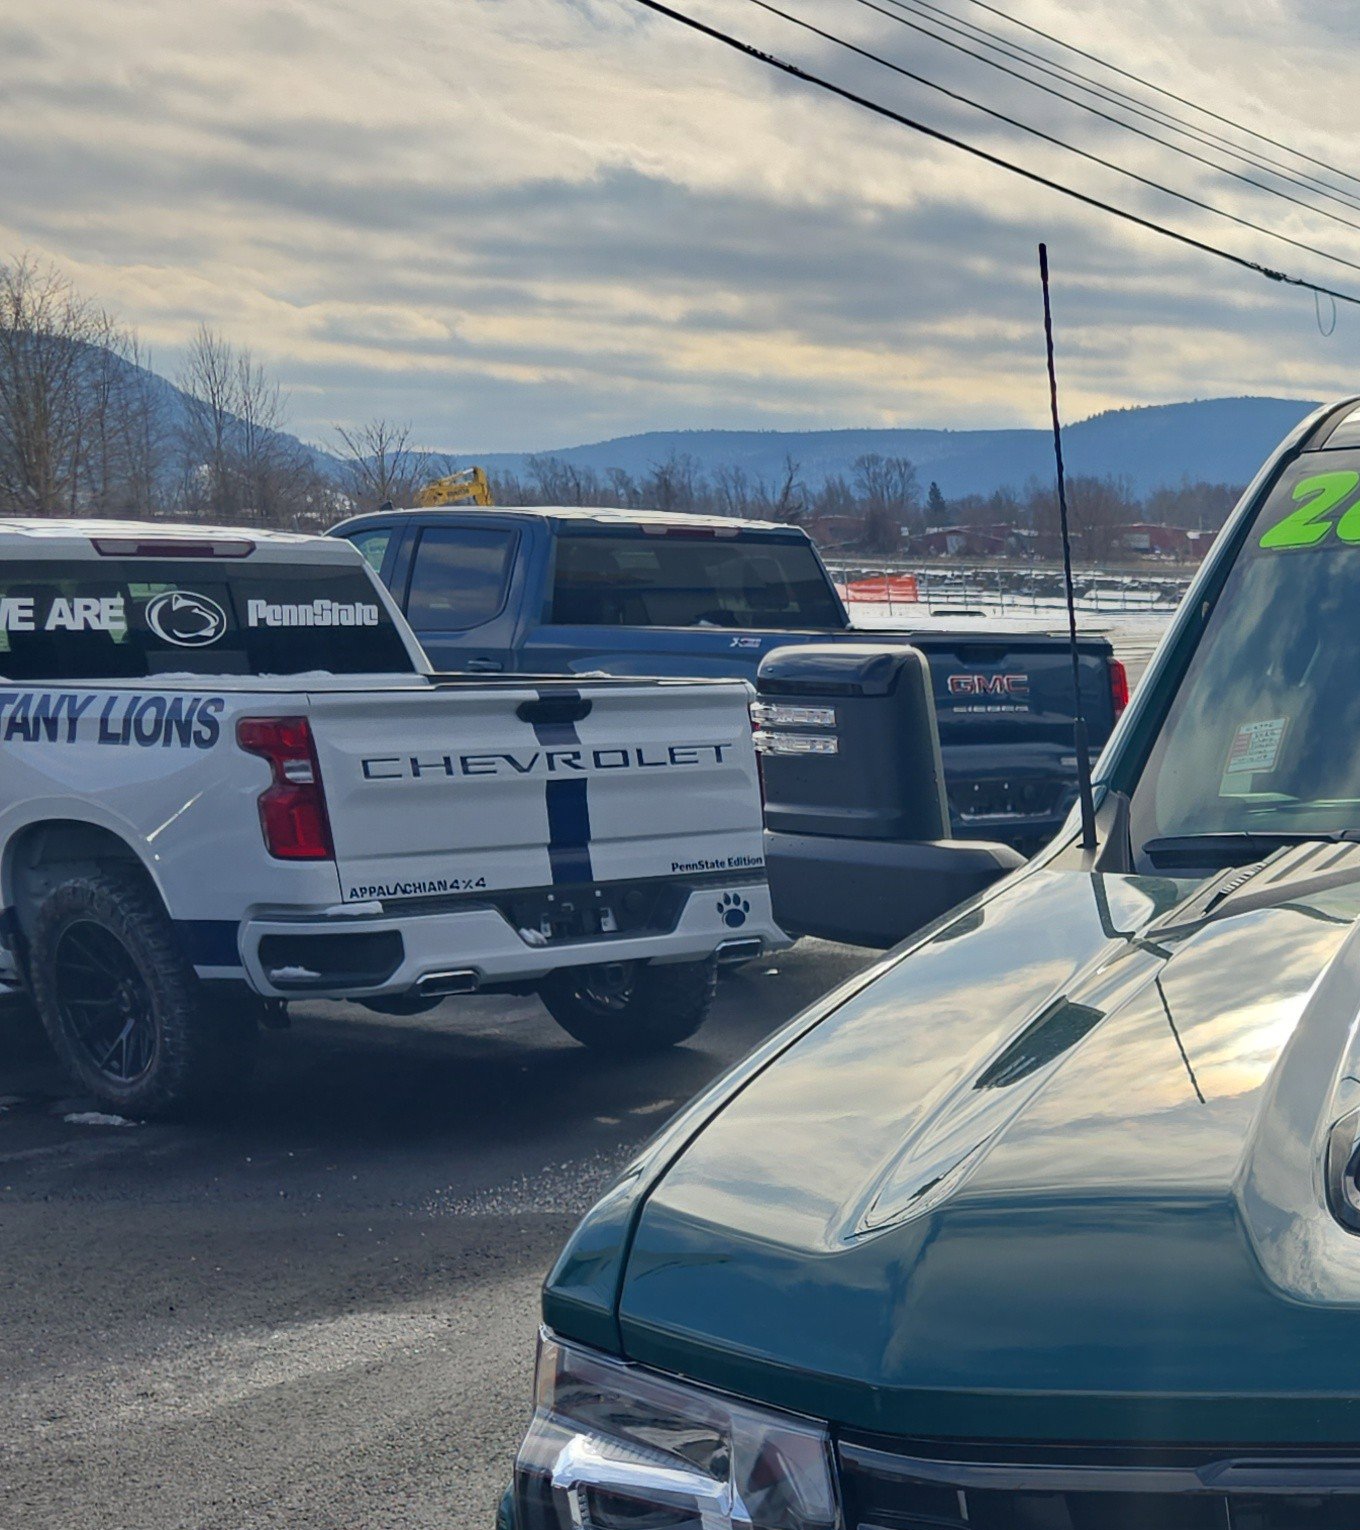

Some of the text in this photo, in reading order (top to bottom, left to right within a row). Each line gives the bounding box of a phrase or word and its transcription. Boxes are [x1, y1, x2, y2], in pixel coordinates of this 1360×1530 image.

[0, 598, 125, 631] E ARE
[248, 600, 379, 627] PennState
[947, 674, 1029, 694] GMC
[98, 695, 225, 749] LIONS
[361, 743, 732, 779] CHEVROLET
[671, 855, 763, 873] PennState Edition
[349, 879, 448, 899] APPALACHIAN
